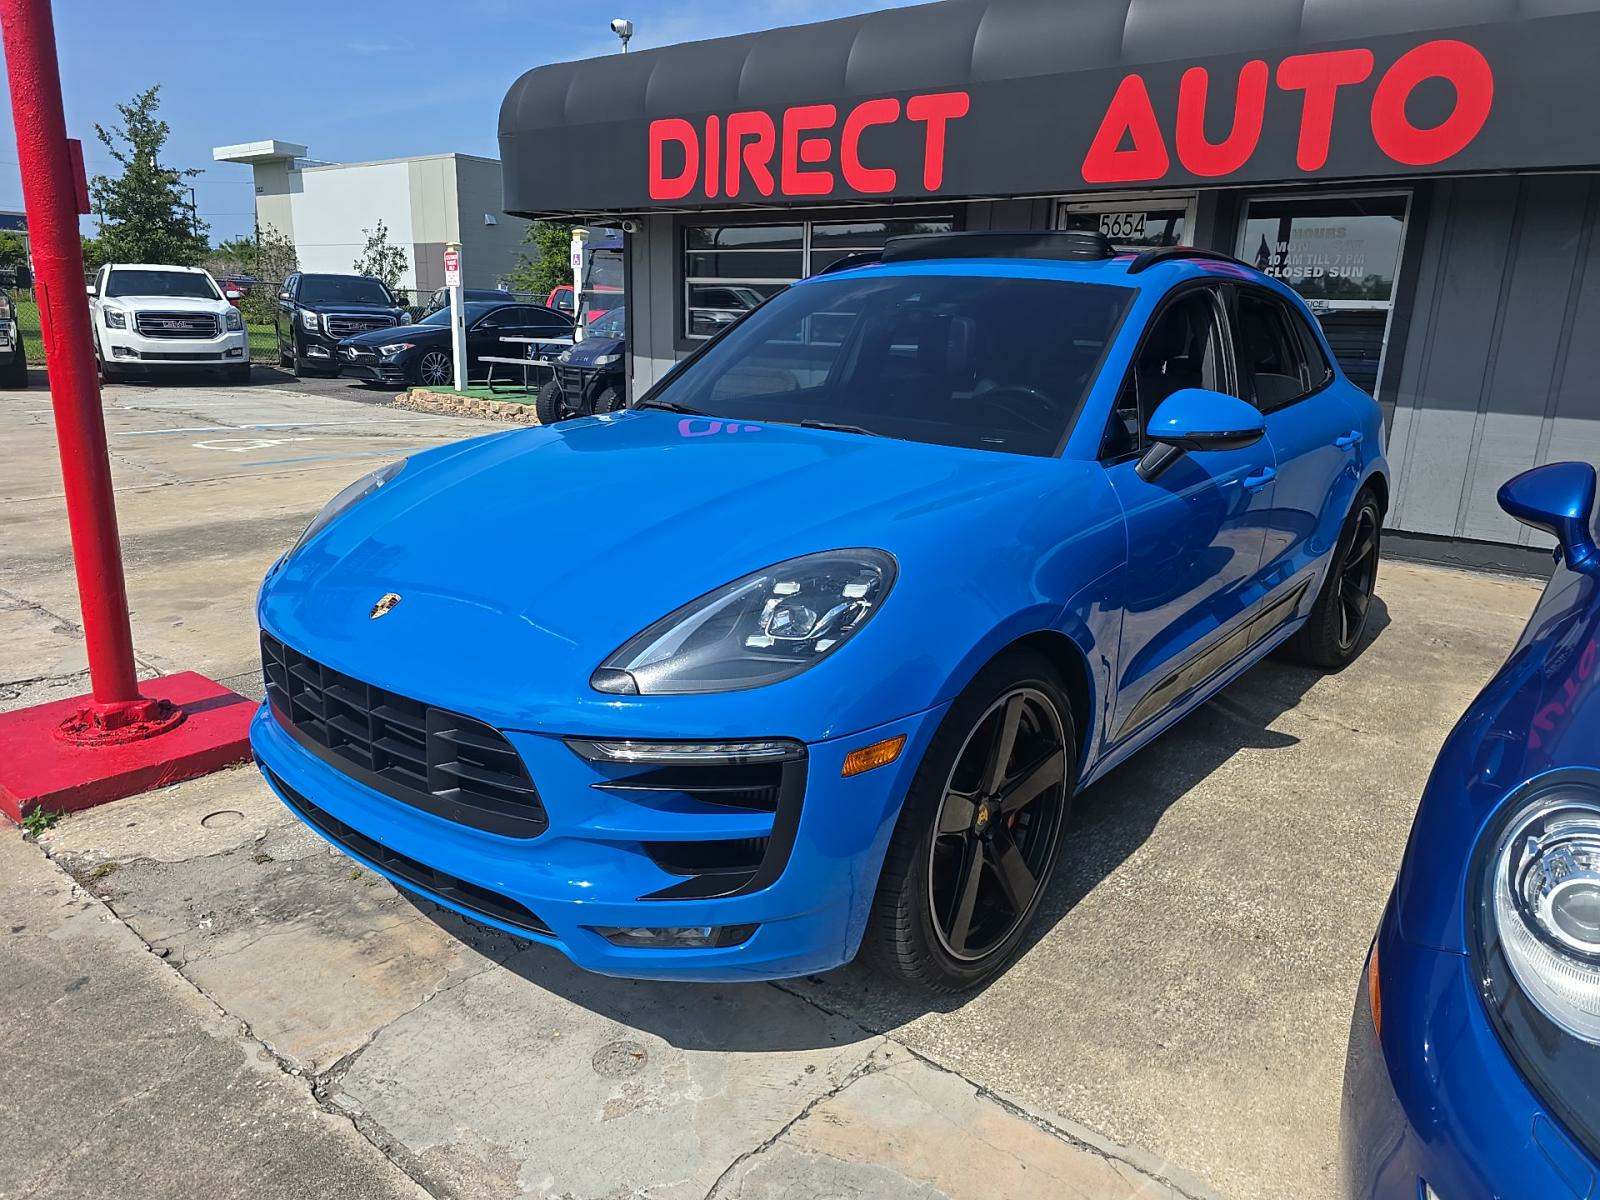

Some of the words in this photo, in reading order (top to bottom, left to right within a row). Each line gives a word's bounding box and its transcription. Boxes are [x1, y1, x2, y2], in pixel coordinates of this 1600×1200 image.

[649, 91, 969, 200] DIRECT
[1081, 40, 1494, 184] AUTO
[1101, 213, 1145, 237] 5654
[1292, 227, 1347, 239] HOURS
[1268, 254, 1281, 265] 10
[1283, 254, 1302, 265] AM
[1306, 254, 1330, 265] TILL
[1334, 254, 1341, 265] 7
[1346, 254, 1366, 265] PM
[1264, 266, 1325, 278] CLOSED
[1329, 266, 1364, 278] SUN
